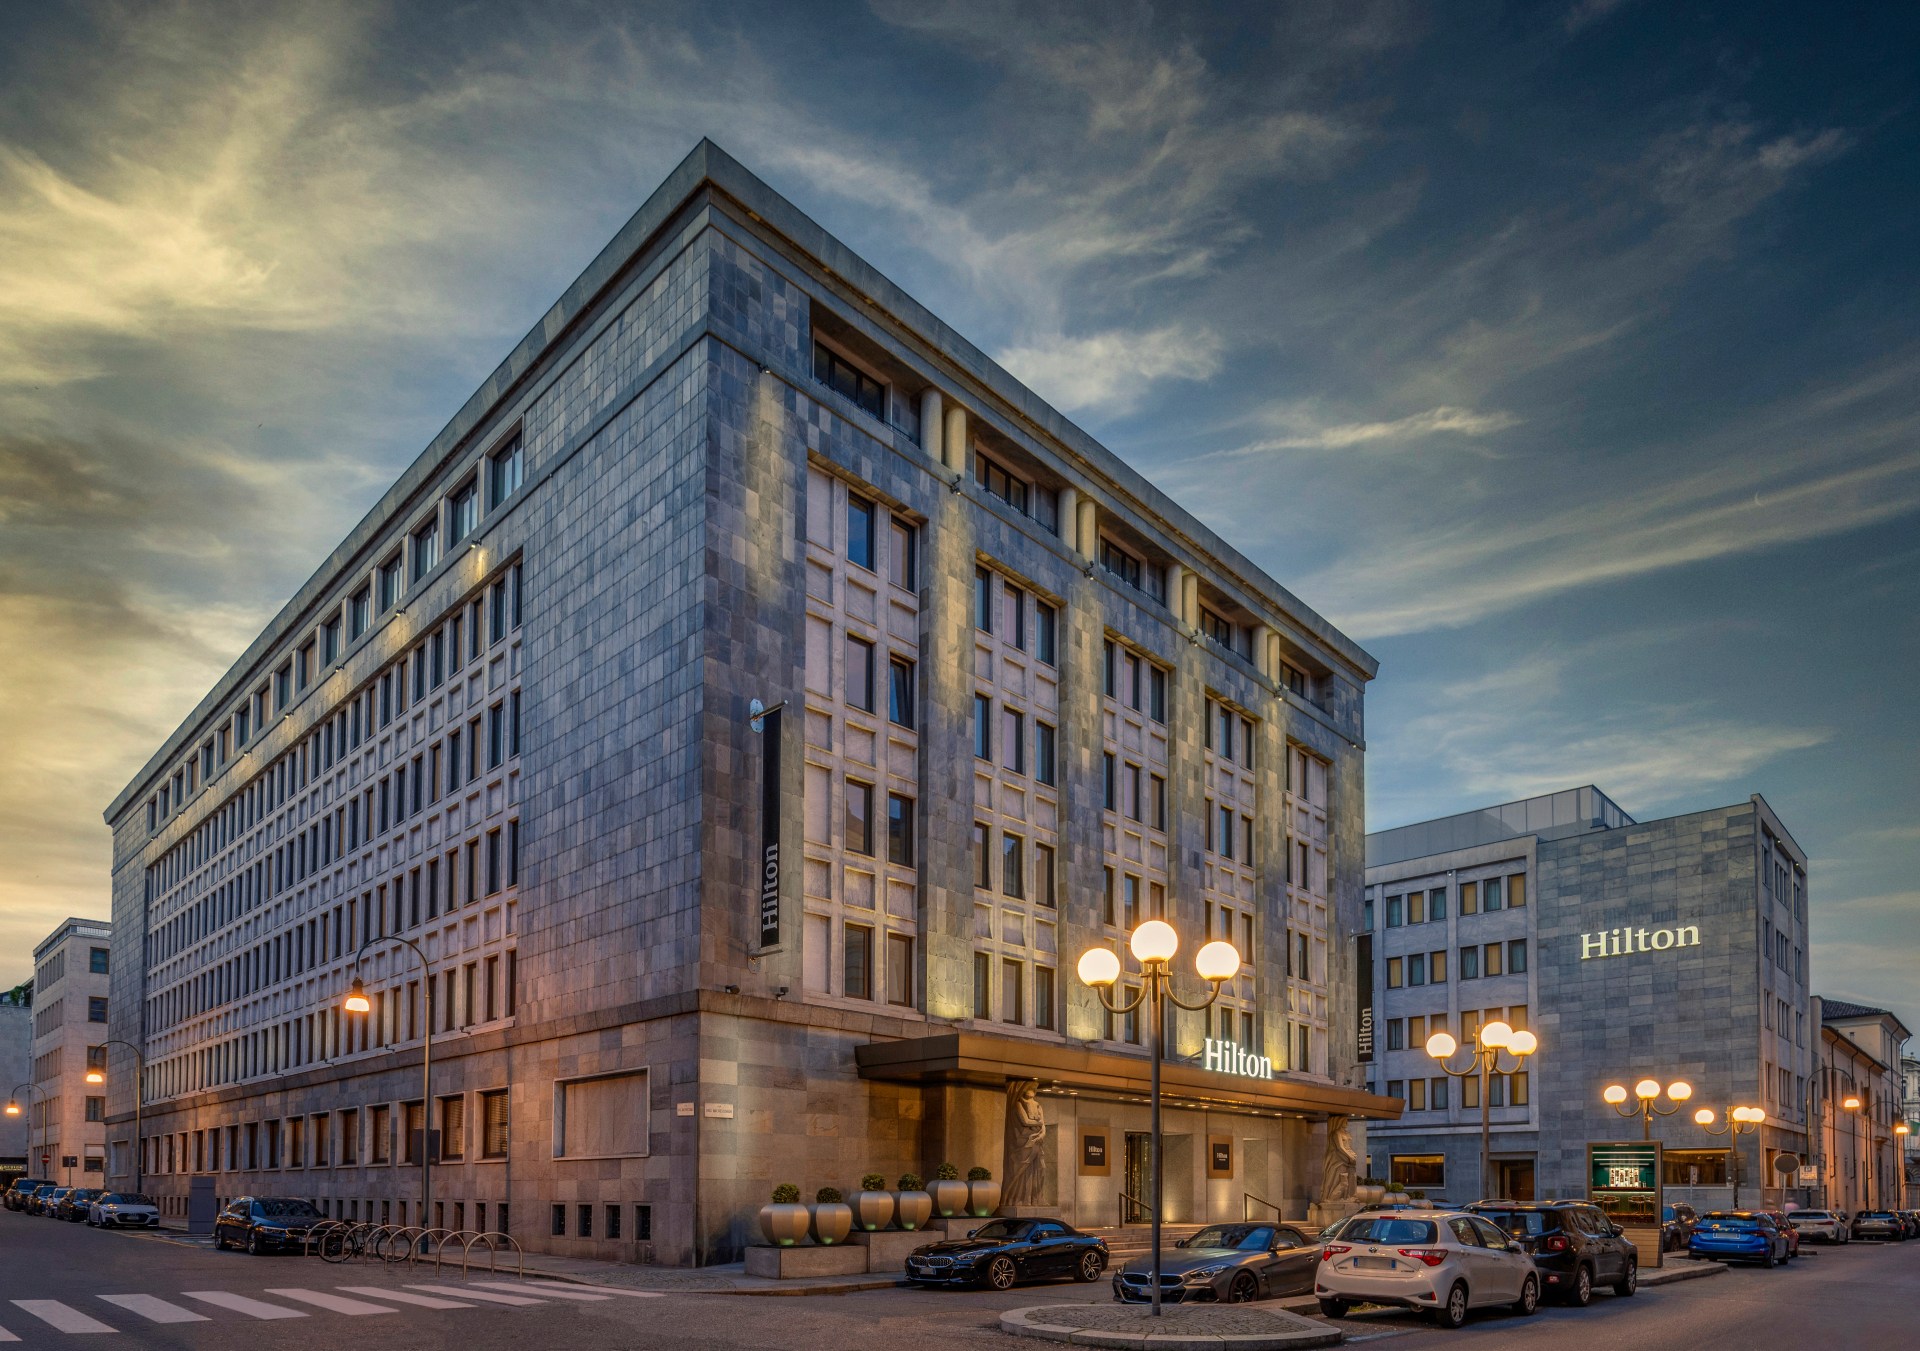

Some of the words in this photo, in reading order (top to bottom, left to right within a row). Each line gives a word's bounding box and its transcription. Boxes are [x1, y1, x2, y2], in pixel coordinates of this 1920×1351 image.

[762, 842, 779, 933] Hilton
[1580, 924, 1701, 960] Hilton
[1358, 1006, 1372, 1055] Hilton
[1204, 1037, 1273, 1080] Hilton
[1088, 1145, 1103, 1153] Hilton
